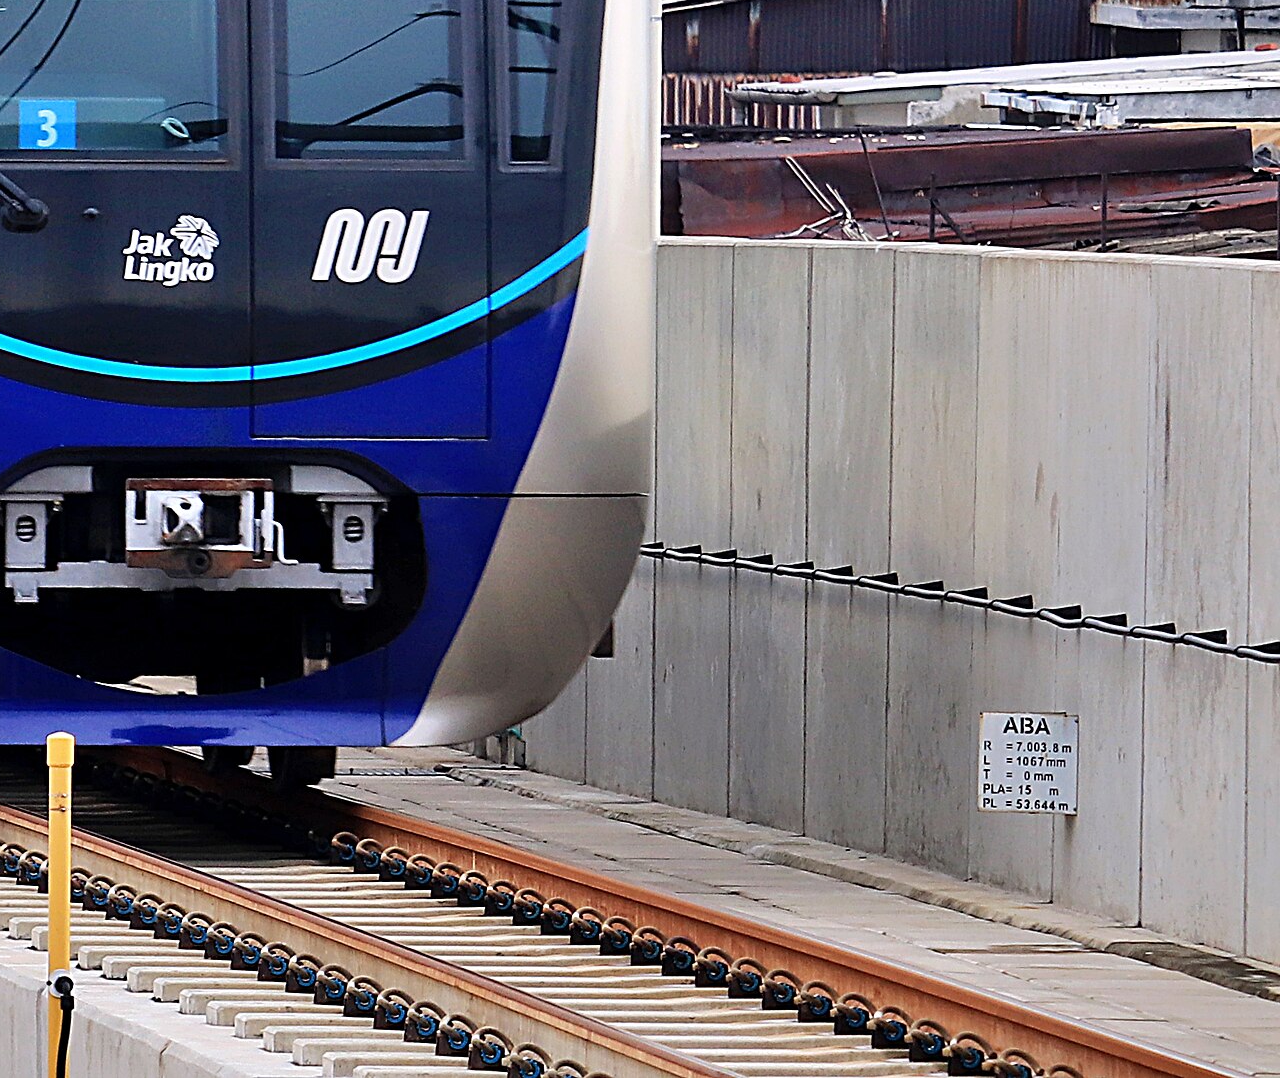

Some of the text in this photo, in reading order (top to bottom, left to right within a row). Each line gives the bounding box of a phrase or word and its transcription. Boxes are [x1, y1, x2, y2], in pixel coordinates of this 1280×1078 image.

[34, 109, 58, 148] 3
[123, 229, 174, 257] Jak
[124, 256, 214, 286] Lingko
[1002, 716, 1051, 735] ABA
[983, 740, 992, 751] R
[1061, 745, 1072, 753] m
[983, 755, 990, 765] L
[983, 769, 991, 779] T
[1023, 770, 1031, 781] 0
[1033, 772, 1054, 781] mm
[1018, 784, 1032, 795] 15
[1049, 787, 1059, 796] m
[982, 798, 997, 809] PL
[1016, 799, 1056, 810] 53.644
[1058, 802, 1069, 811] m
